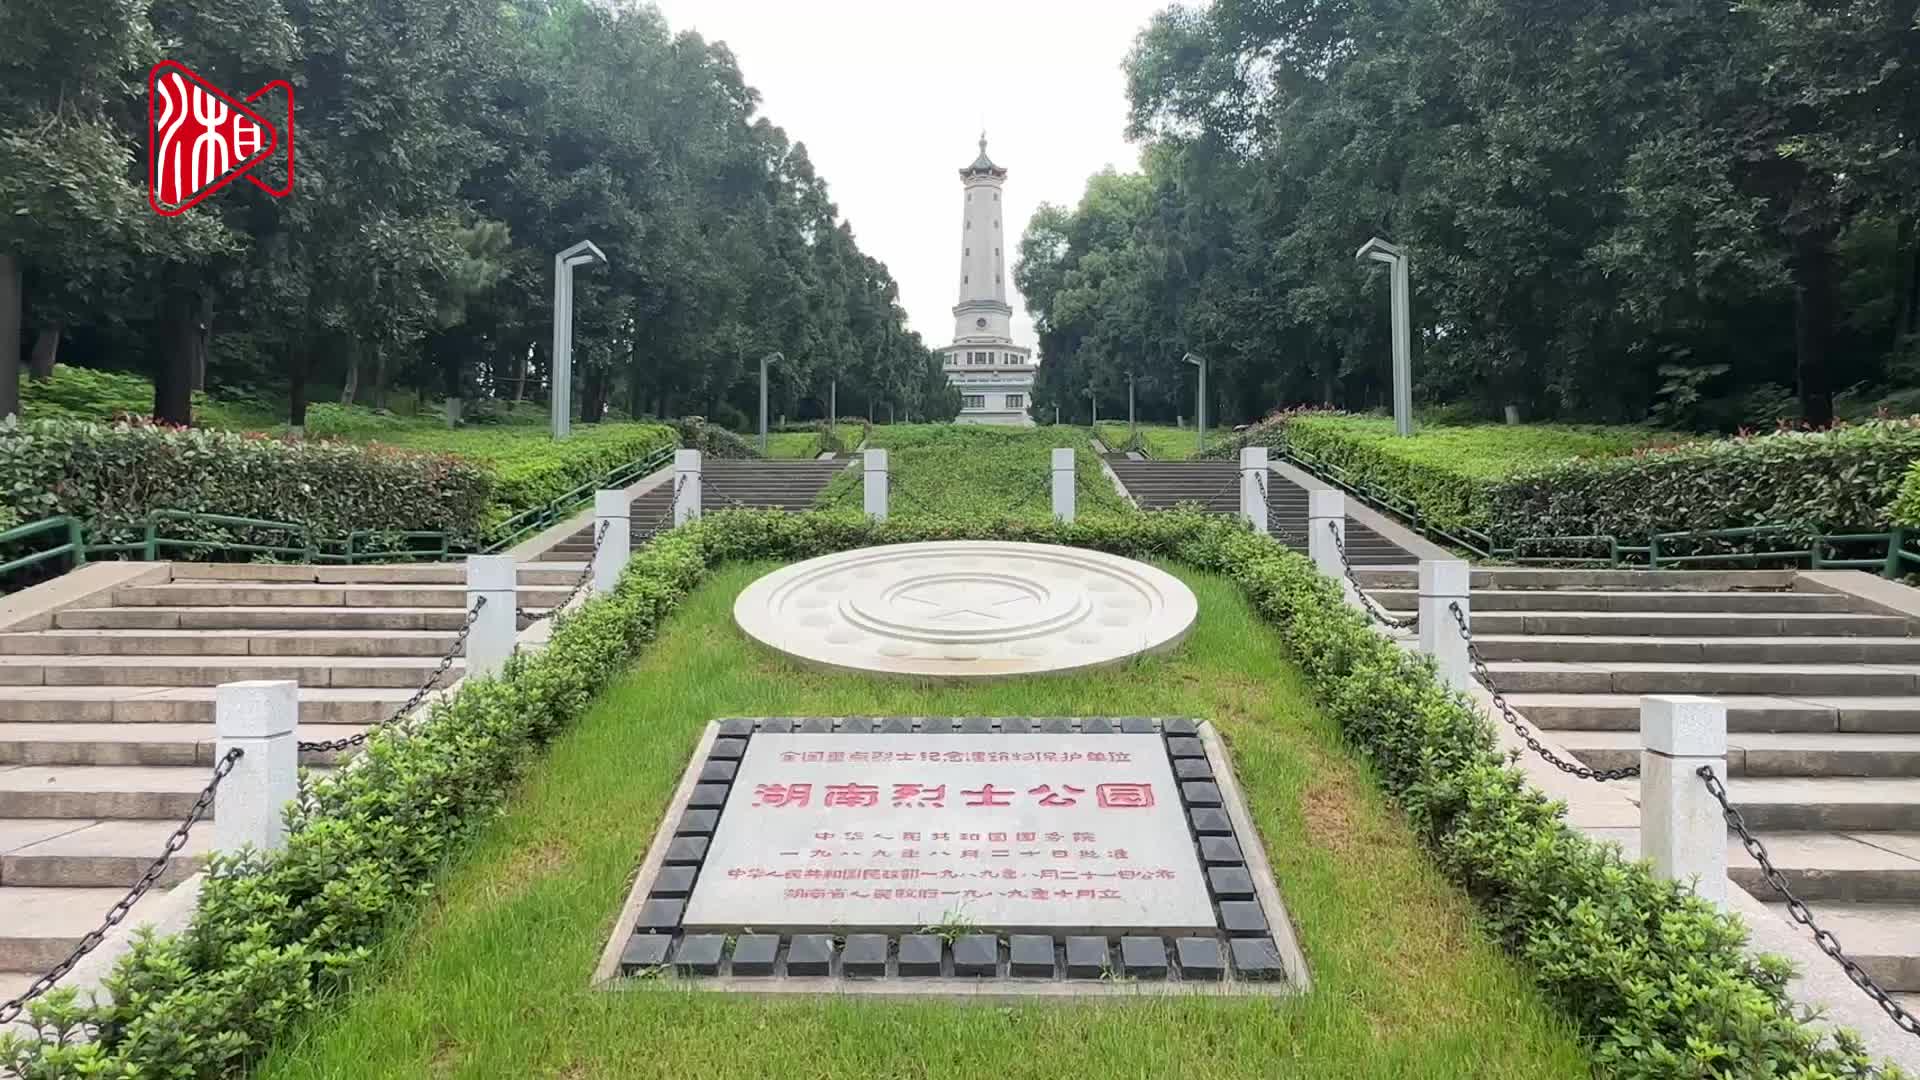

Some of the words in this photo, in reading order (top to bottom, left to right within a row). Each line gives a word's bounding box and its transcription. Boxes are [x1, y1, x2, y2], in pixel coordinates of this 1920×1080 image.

[779, 751, 1131, 763] 全国重点烈士纪念建筑物保护单位
[751, 783, 1155, 808] 湖南烈士公园
[814, 831, 1097, 842] 中华人民共和国国务院
[779, 848, 1129, 859] 一九八九年八月二十日批准
[727, 868, 1176, 881] 中华人民共和国民政部一九八九年八月二十一日公布
[784, 888, 1121, 899] 湖南省人民政府一九八九年十月立
